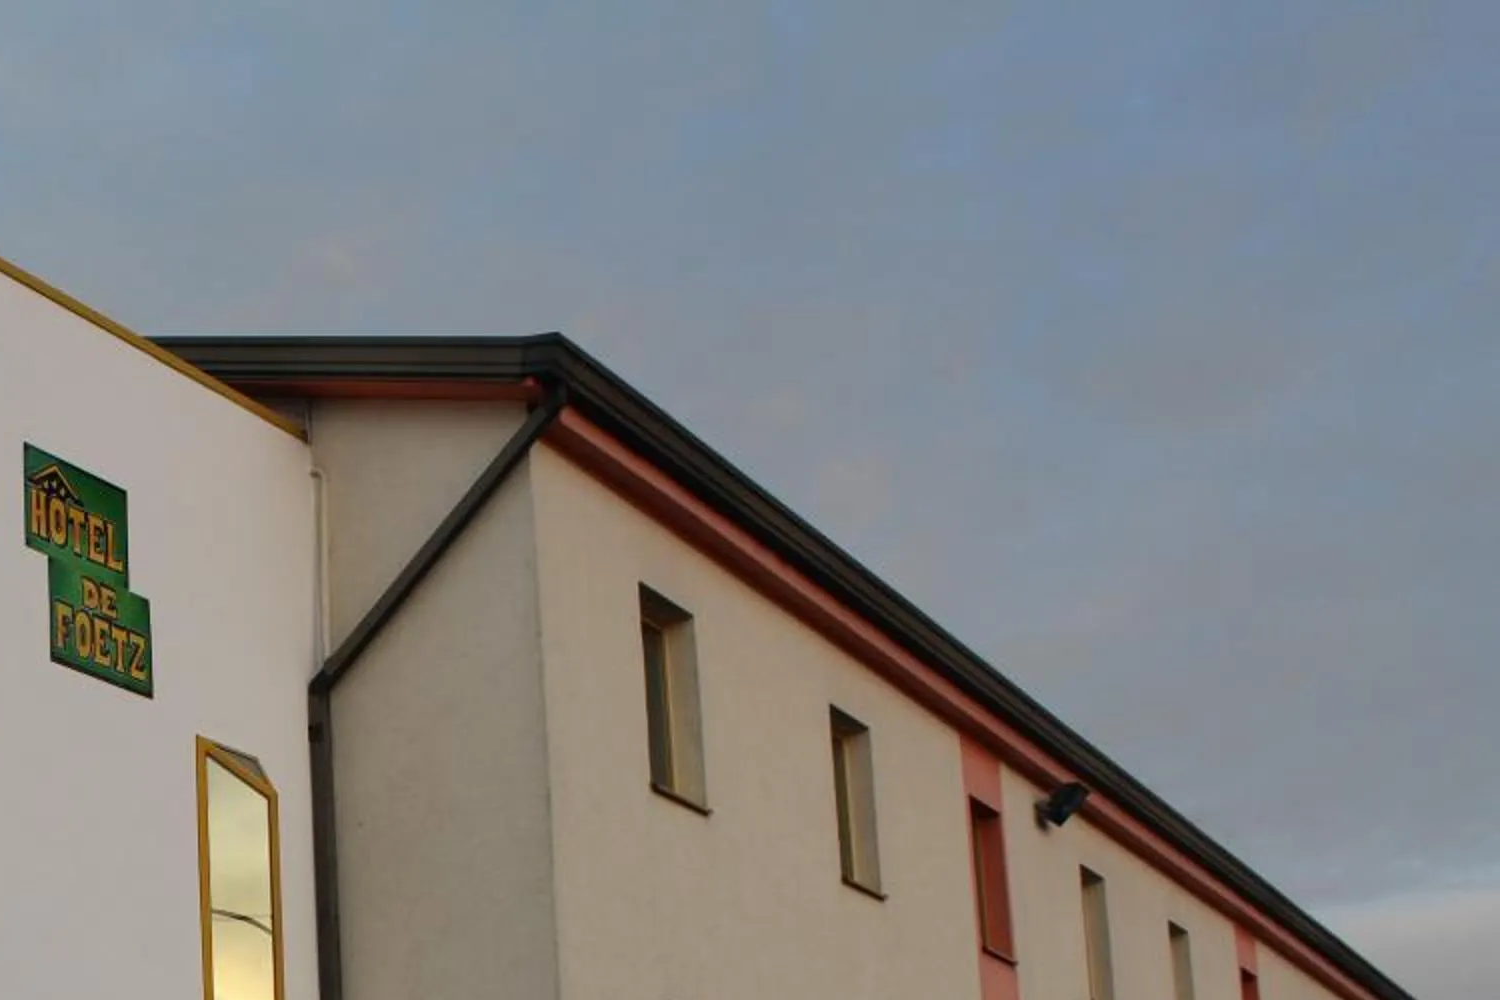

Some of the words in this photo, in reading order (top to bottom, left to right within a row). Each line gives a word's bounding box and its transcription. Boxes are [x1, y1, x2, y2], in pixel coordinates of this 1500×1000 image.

[30, 488, 124, 573] HOTEL
[81, 576, 118, 620] DE
[53, 599, 148, 681] FOETZ
